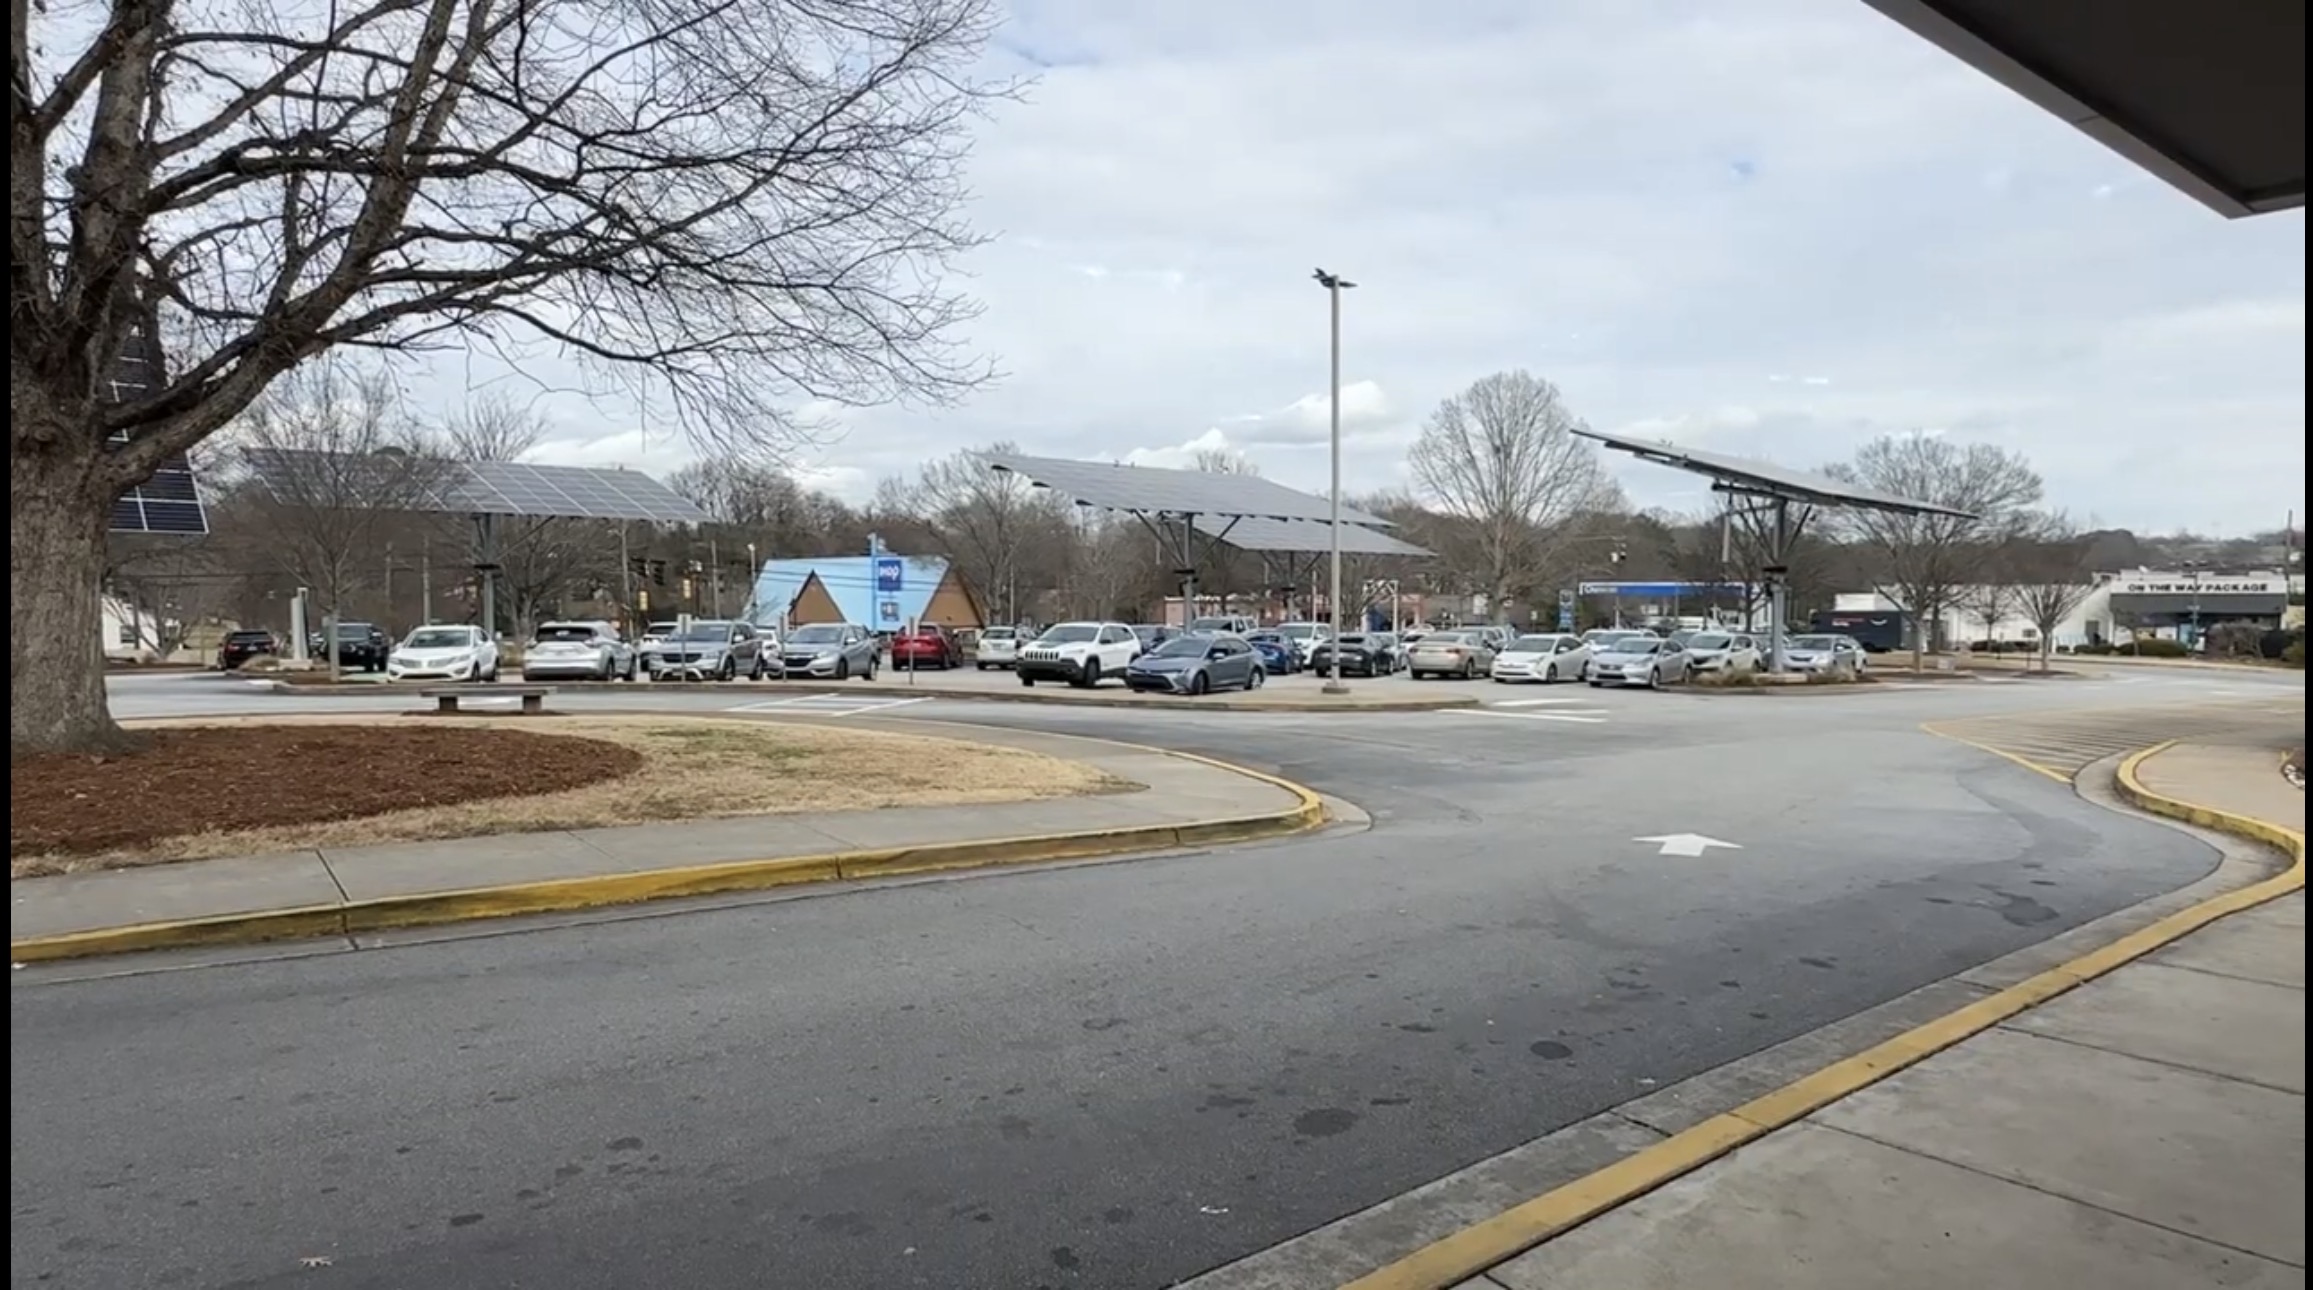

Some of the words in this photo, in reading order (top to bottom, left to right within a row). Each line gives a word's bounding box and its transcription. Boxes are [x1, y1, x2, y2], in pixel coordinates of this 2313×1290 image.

[2127, 583, 2145, 592] ON
[2148, 583, 2171, 592] THE
[2175, 583, 2203, 592] WAY
[2205, 583, 2269, 592] PACKAGE
